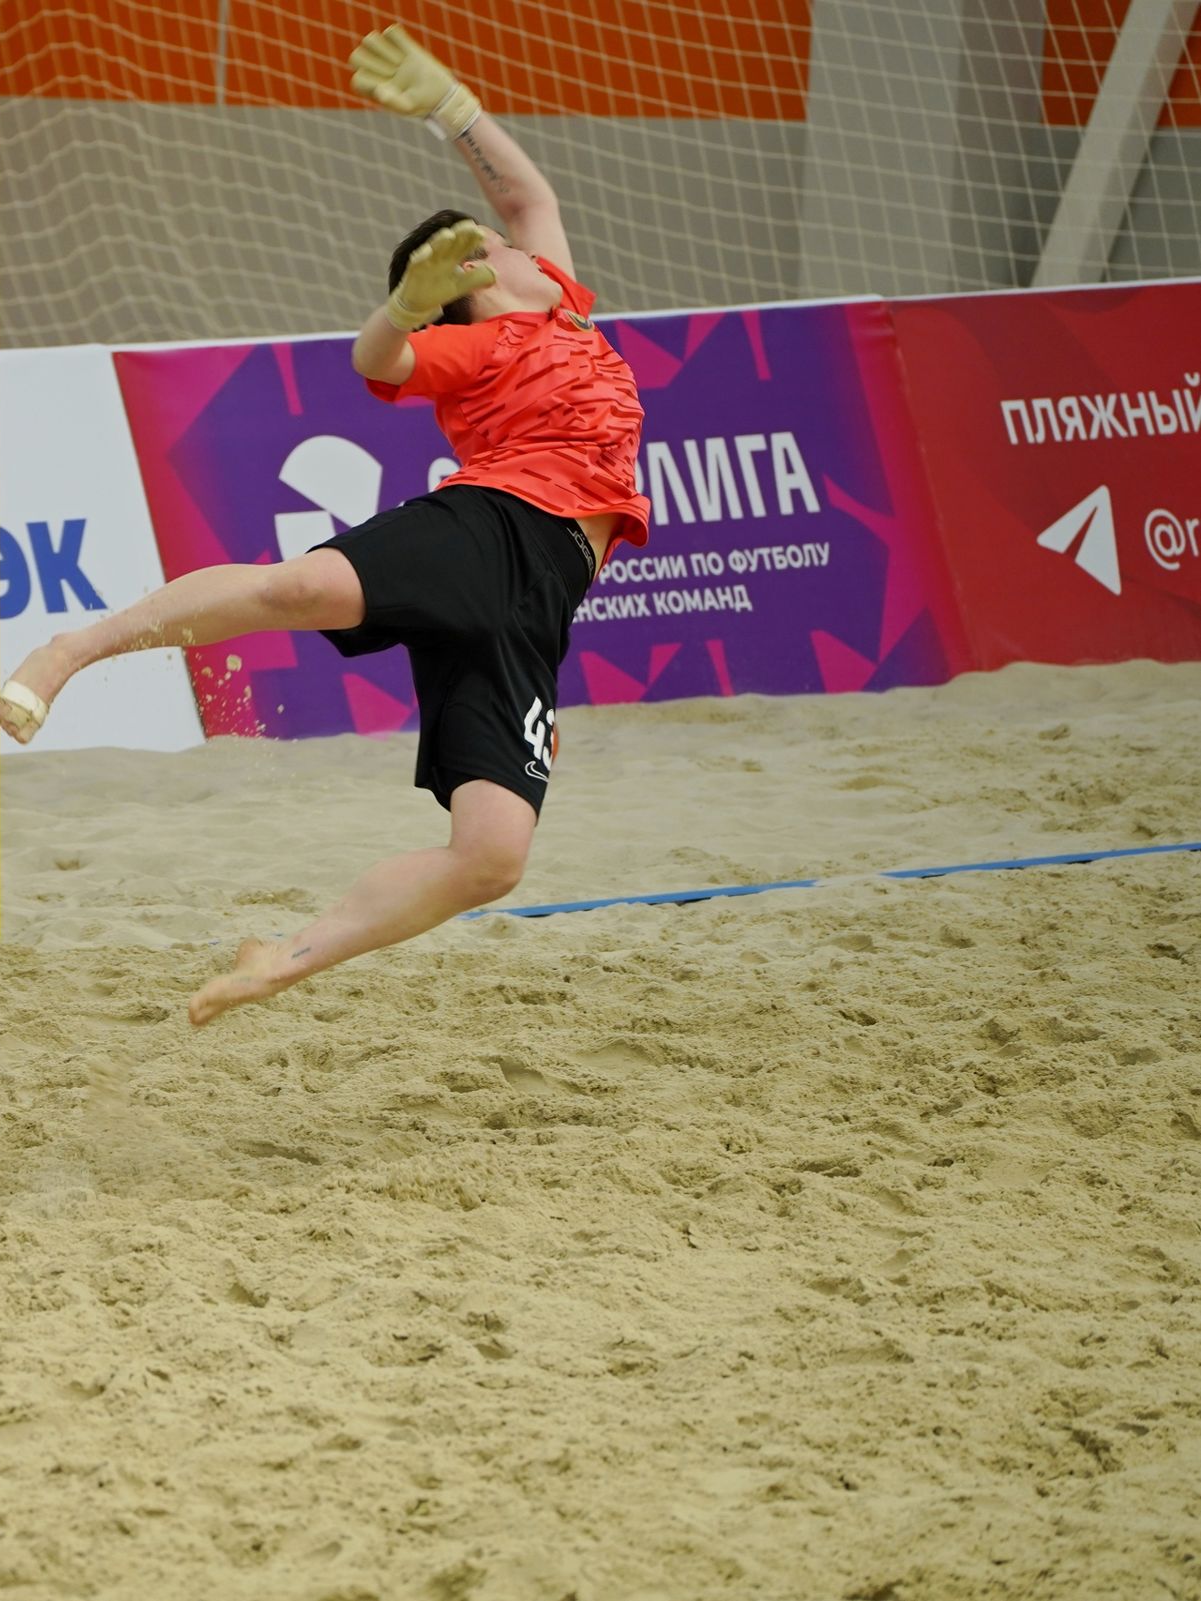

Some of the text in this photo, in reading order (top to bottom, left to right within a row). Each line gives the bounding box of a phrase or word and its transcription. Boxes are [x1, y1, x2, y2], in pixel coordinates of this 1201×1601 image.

[1000, 372, 1201, 445] ПЛЯЖНЫЙ
[599, 542, 830, 585] РОССИИ ПО ФУТБОЛУ
[572, 584, 753, 624] НСКИХ КОМАНД
